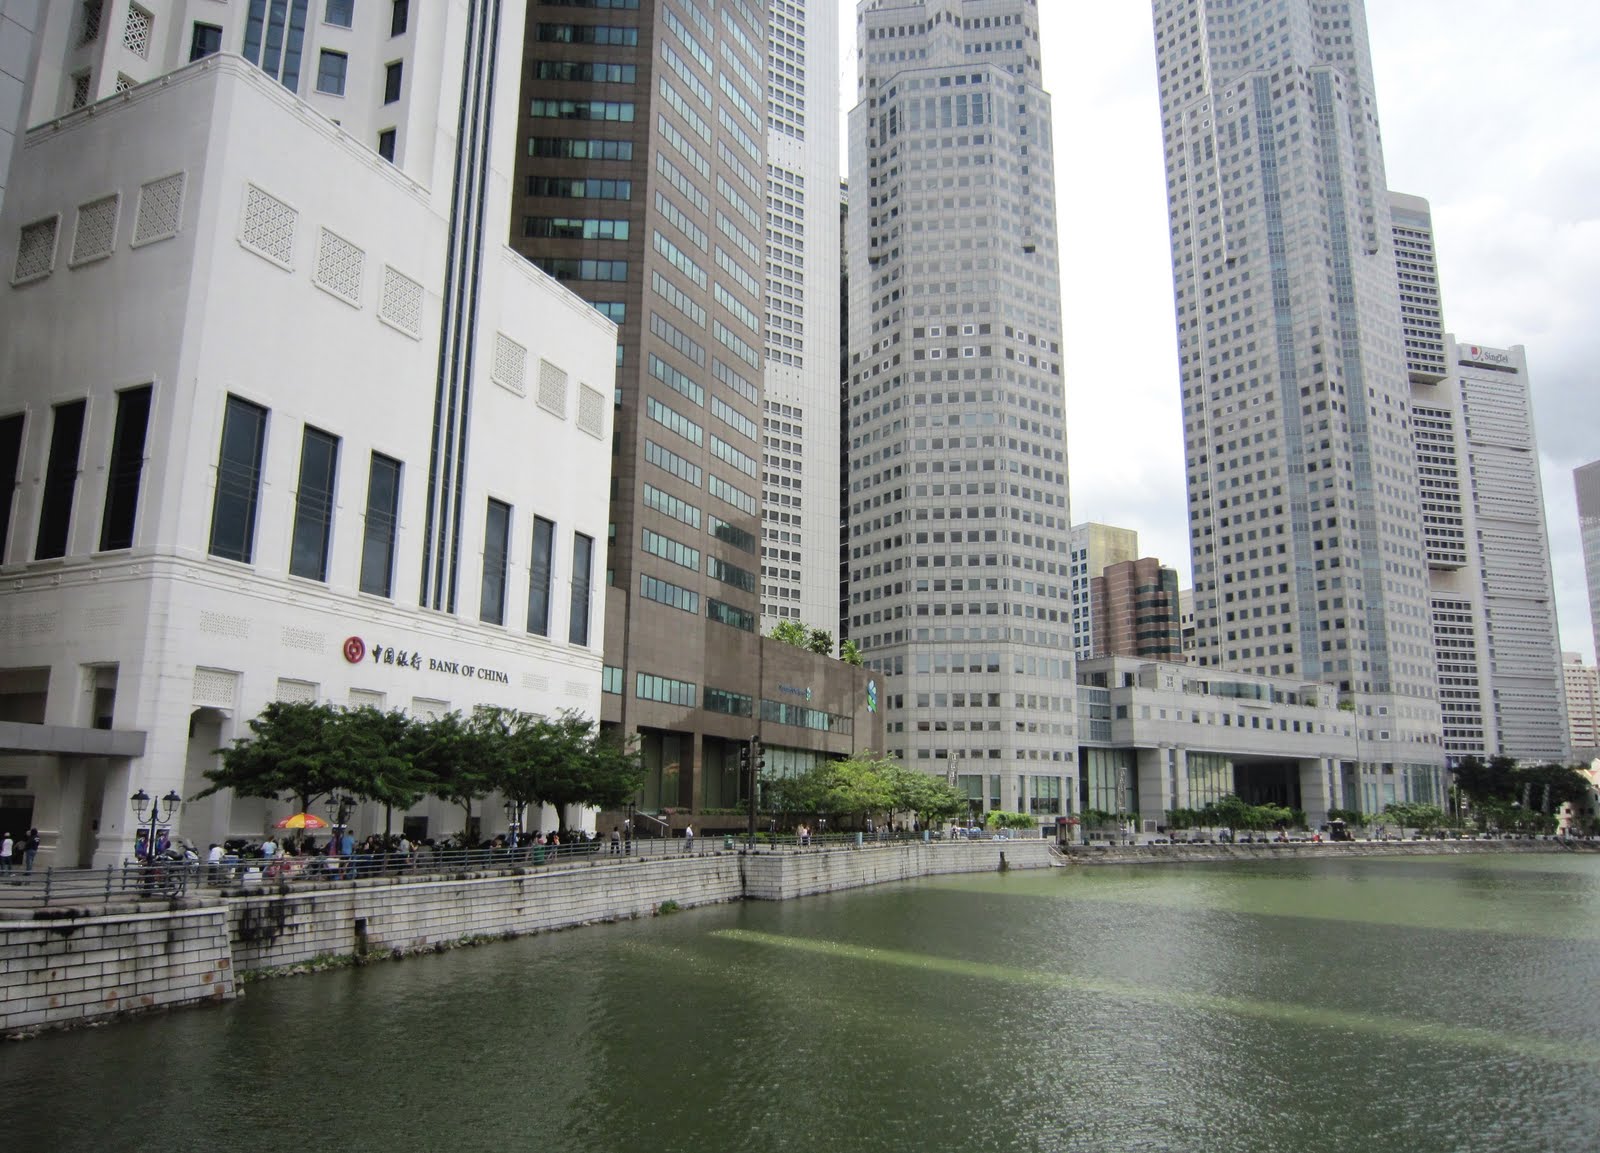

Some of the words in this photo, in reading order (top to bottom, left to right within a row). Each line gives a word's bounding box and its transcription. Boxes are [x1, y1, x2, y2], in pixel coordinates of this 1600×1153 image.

[1484, 352, 1509, 363] SingTel
[429, 658, 459, 674] BANK
[461, 665, 475, 677] OF
[477, 668, 509, 684] CHINA
